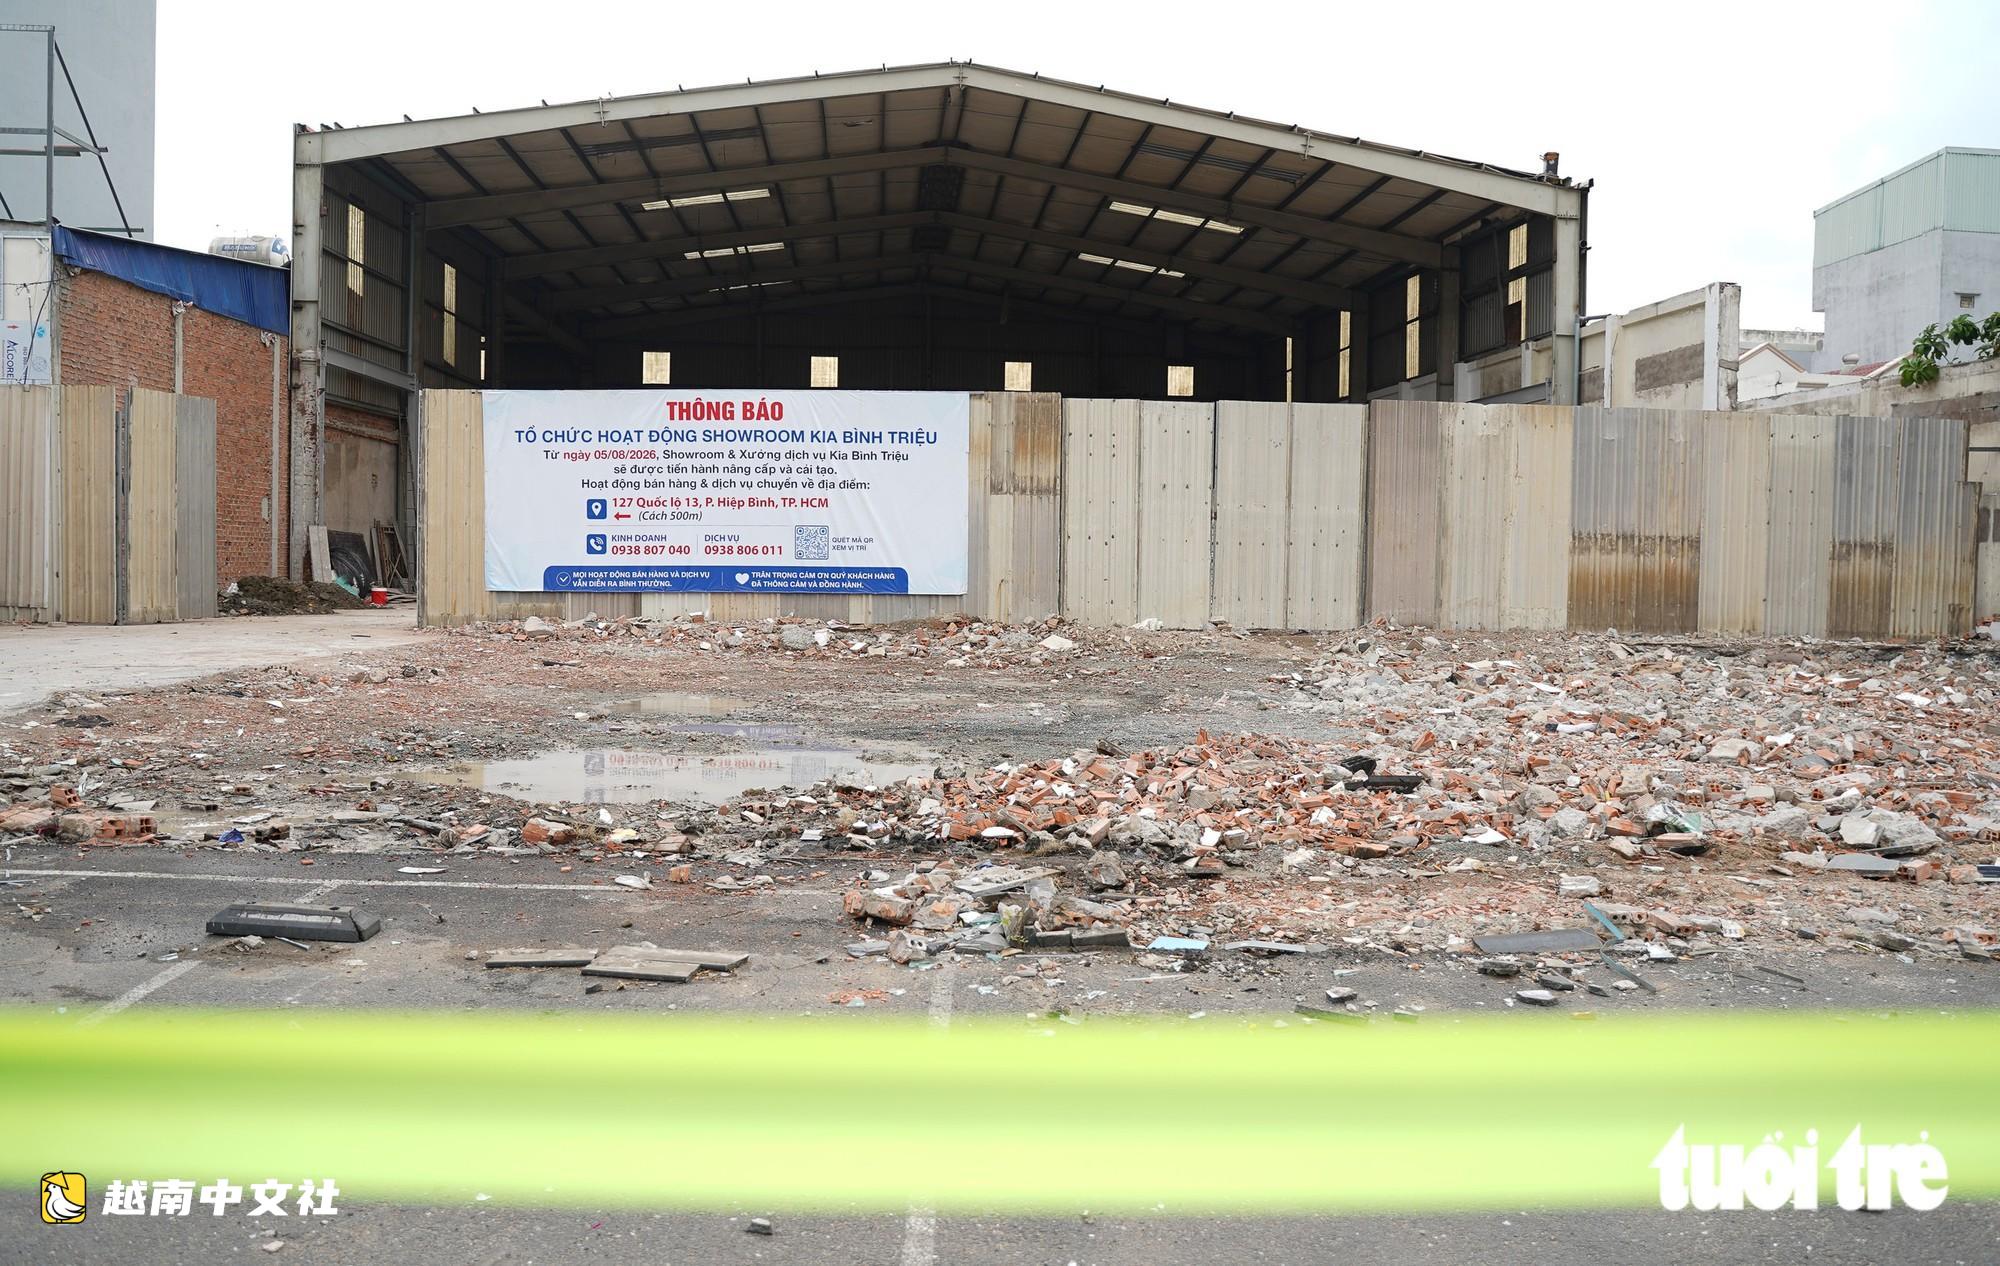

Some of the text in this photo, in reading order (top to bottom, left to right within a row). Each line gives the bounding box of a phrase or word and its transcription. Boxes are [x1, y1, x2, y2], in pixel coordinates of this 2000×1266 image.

[666, 397, 784, 421] THÔNG BÁO
[515, 425, 938, 446] TỔ CHỨC HOẠT ĐỘNG SHOWROOM KIA BÌNH TRIỆU
[544, 449, 909, 462] Từ ngày 05/08/2026, Showroom & Xưởng dịch vụ Kia Bình Triệu
[614, 465, 627, 474] sẽ
[630, 465, 663, 476] được
[667, 463, 688, 474] tiến
[691, 464, 719, 474] hành
[722, 465, 751, 476] nâng
[754, 463, 776, 476] cấp
[779, 464, 792, 474] và
[816, 465, 838, 477] tạo.
[581, 479, 608, 490] Hoạt
[611, 479, 640, 490] động
[644, 479, 665, 489] bán
[668, 479, 697, 490] hàng
[700, 479, 709, 489] &
[712, 479, 736, 490] dịch
[740, 481, 753, 490] vụ
[801, 478, 815, 489] về
[818, 479, 836, 491] địa
[612, 496, 829, 510] 127 Quốc lộ 13, P. Hiệp Bình, TP. HCM
[638, 511, 703, 521] (Cách 500m)
[611, 534, 667, 542] KINH DOANH
[704, 534, 740, 543] DỊCH VỤ
[611, 545, 691, 555] 0938 807 040
[704, 545, 783, 555] 0938 806 011
[609, 570, 631, 579] ĐỘNG
[632, 570, 647, 578] BÁN
[648, 570, 669, 578] HÀNG
[670, 570, 680, 578] VÀ
